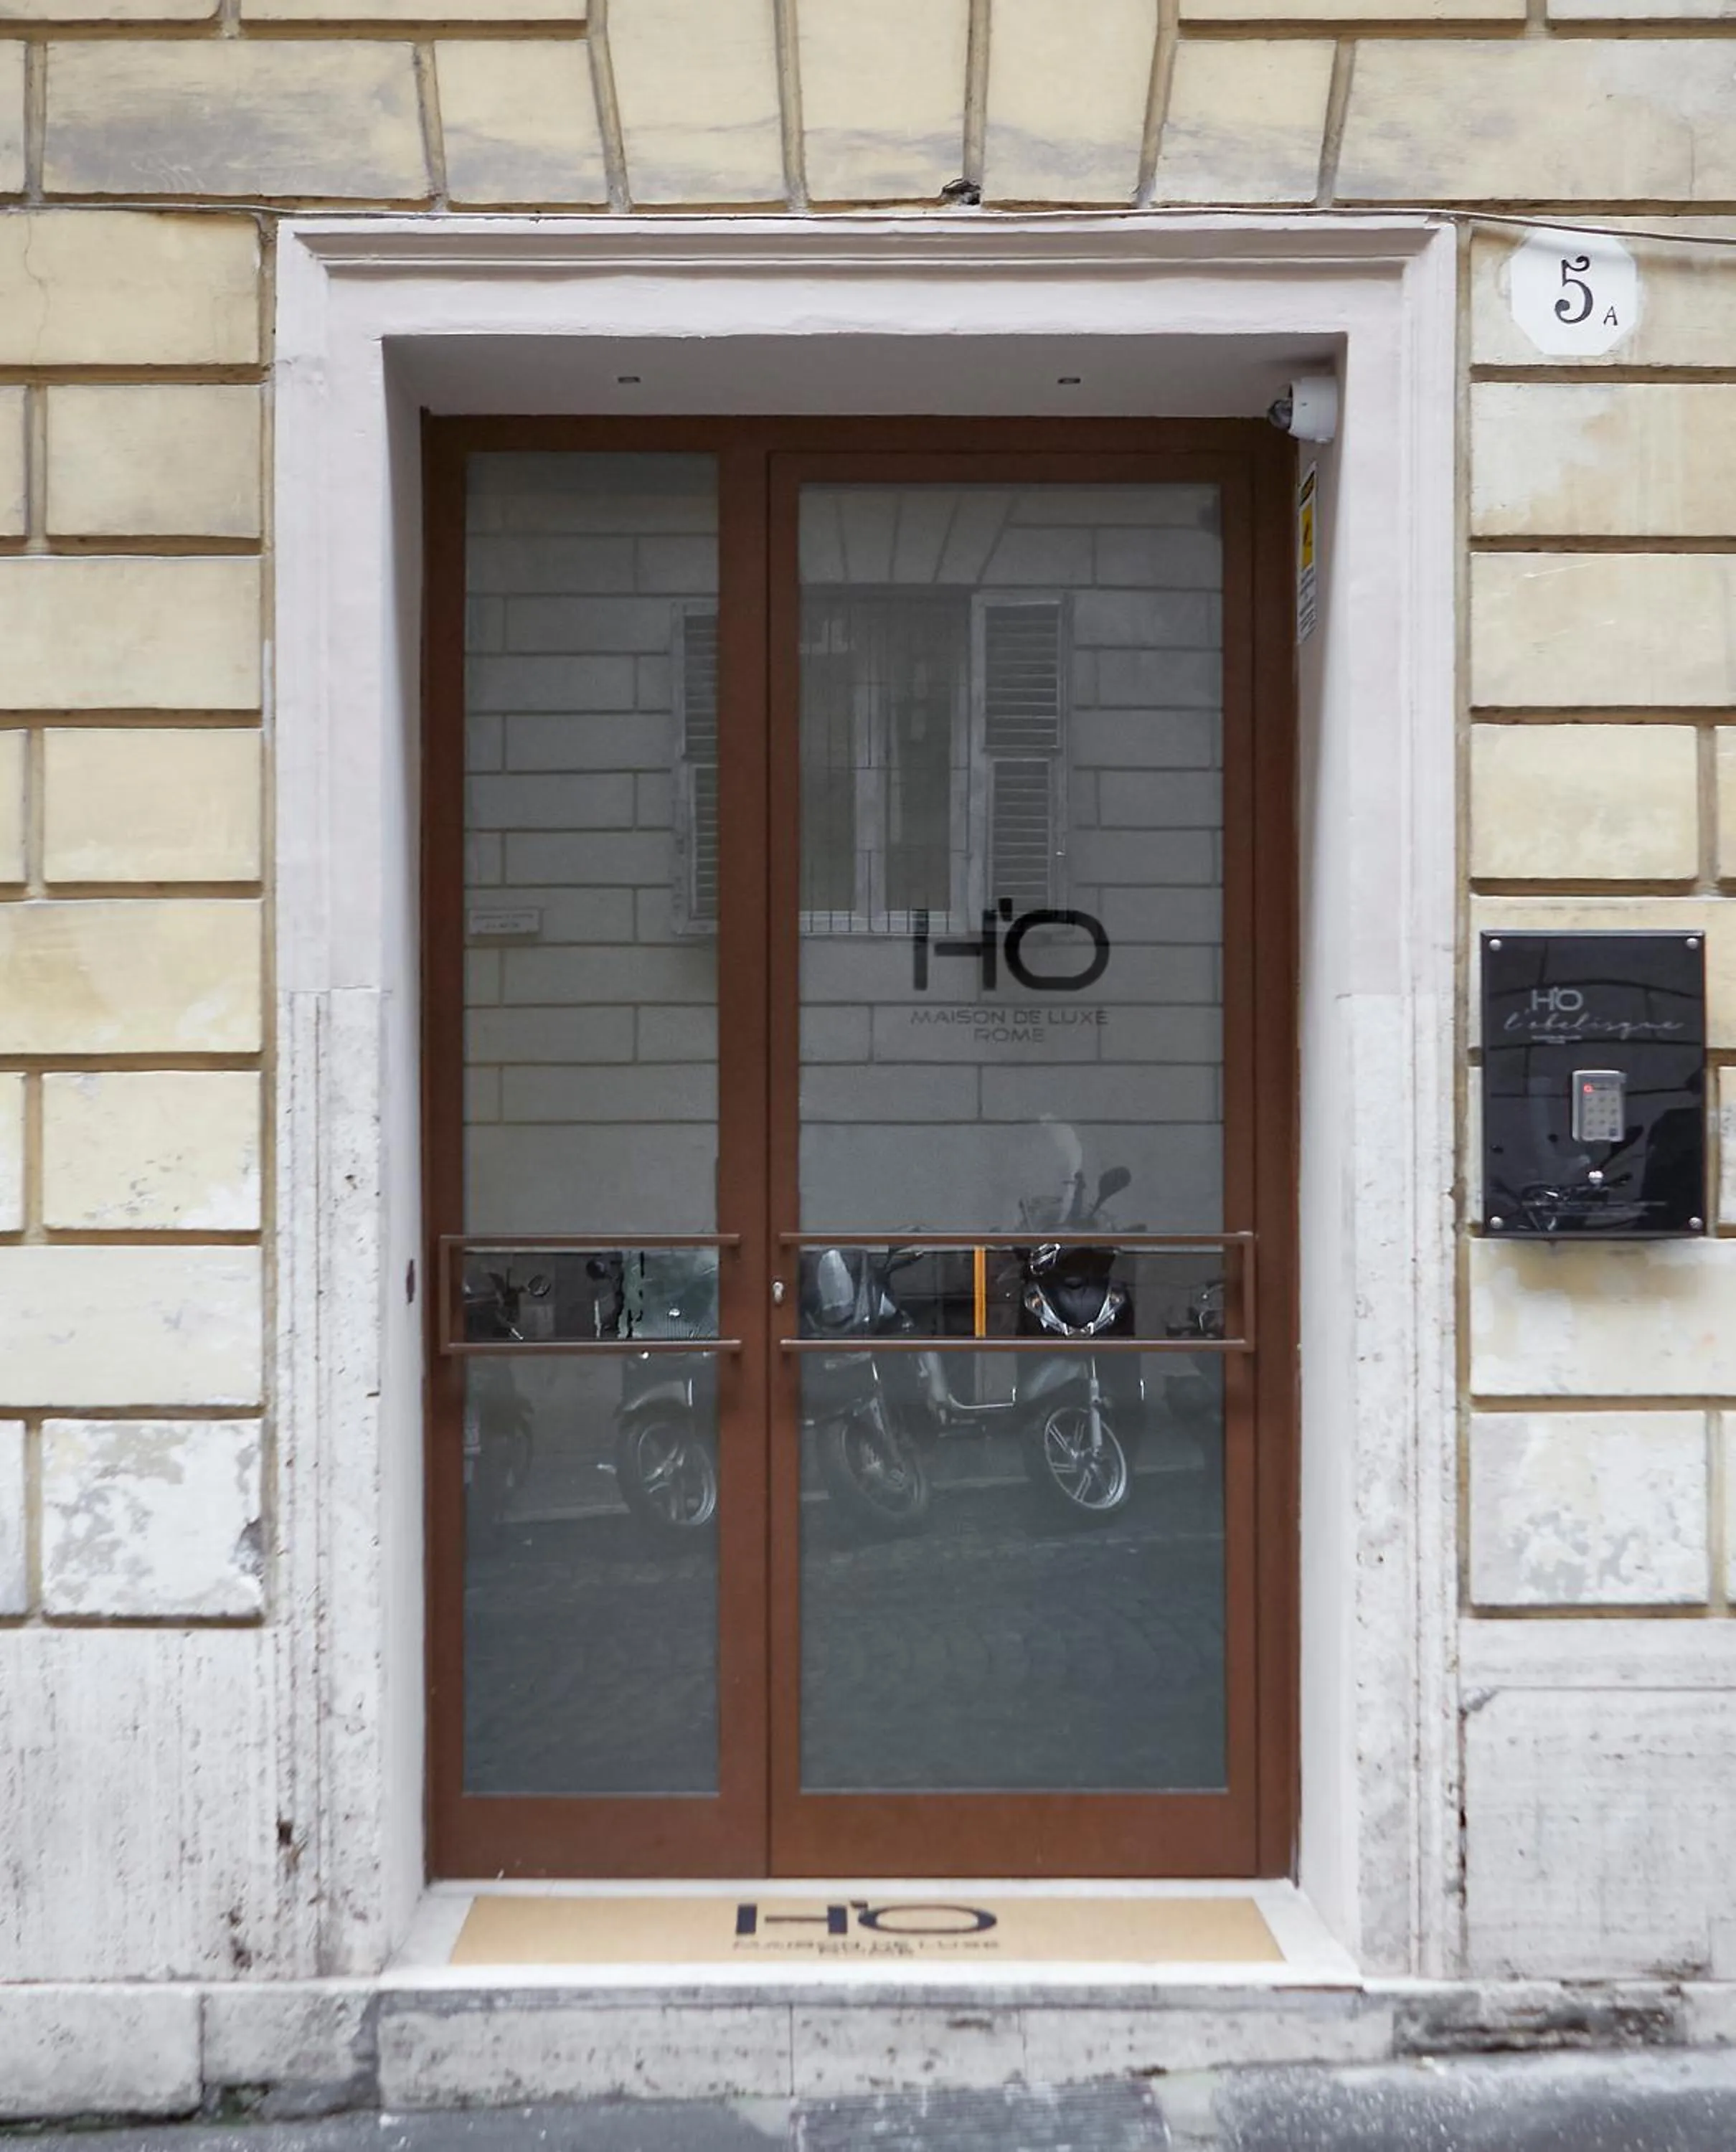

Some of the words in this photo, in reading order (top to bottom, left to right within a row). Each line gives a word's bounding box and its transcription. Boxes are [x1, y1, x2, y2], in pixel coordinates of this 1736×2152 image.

[1555, 255, 1593, 324] 5
[910, 1010, 1006, 1025] MAISON
[1013, 1010, 1042, 1025] DE
[1048, 1010, 1110, 1026] LUXE
[973, 1028, 1046, 1042] ROME
